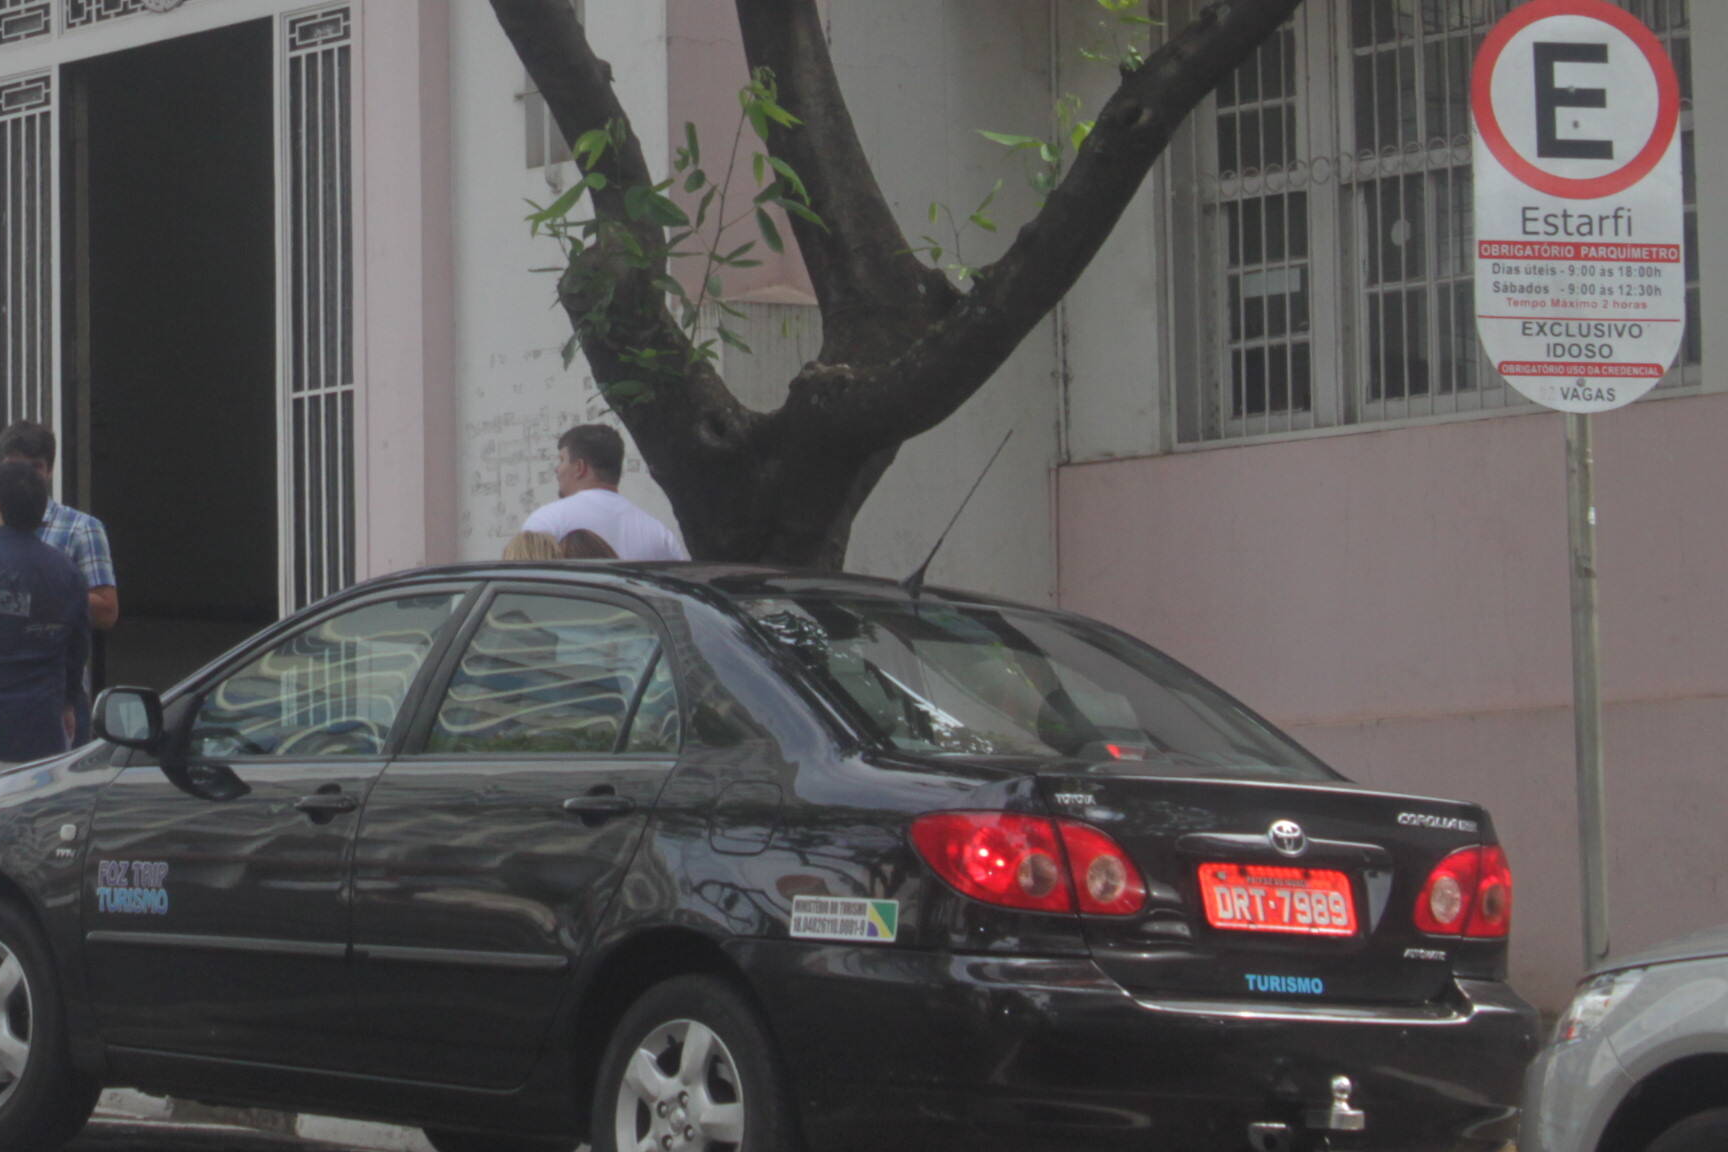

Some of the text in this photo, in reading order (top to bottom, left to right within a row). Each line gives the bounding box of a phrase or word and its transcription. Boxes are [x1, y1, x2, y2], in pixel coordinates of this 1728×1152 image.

[1533, 42, 1614, 160] E
[1521, 206, 1633, 238] Estarfi
[1480, 242, 1679, 260] OBRIGATÓRIO PARQUÍMETRO
[1491, 263, 1521, 275] Dias
[1524, 263, 1557, 276] úteis
[1568, 264, 1596, 277] 9:00
[1618, 266, 1662, 278] 18:00h
[1492, 281, 1550, 295] Sábados
[1568, 283, 1596, 296] 9:00
[1618, 284, 1662, 297] 12:30h
[1506, 297, 1547, 309] Tempo
[1602, 299, 1609, 309] 2
[1612, 299, 1648, 310] horas
[1521, 321, 1644, 339] EXCLUSIVO
[1546, 343, 1614, 359] IDOSO
[1602, 365, 1658, 376] CREDENCIAL
[1560, 387, 1617, 403] VAGAS
[98, 860, 169, 888] FOZ TRIP
[96, 887, 169, 916] TURISMO
[1244, 973, 1325, 995] TURISMO
